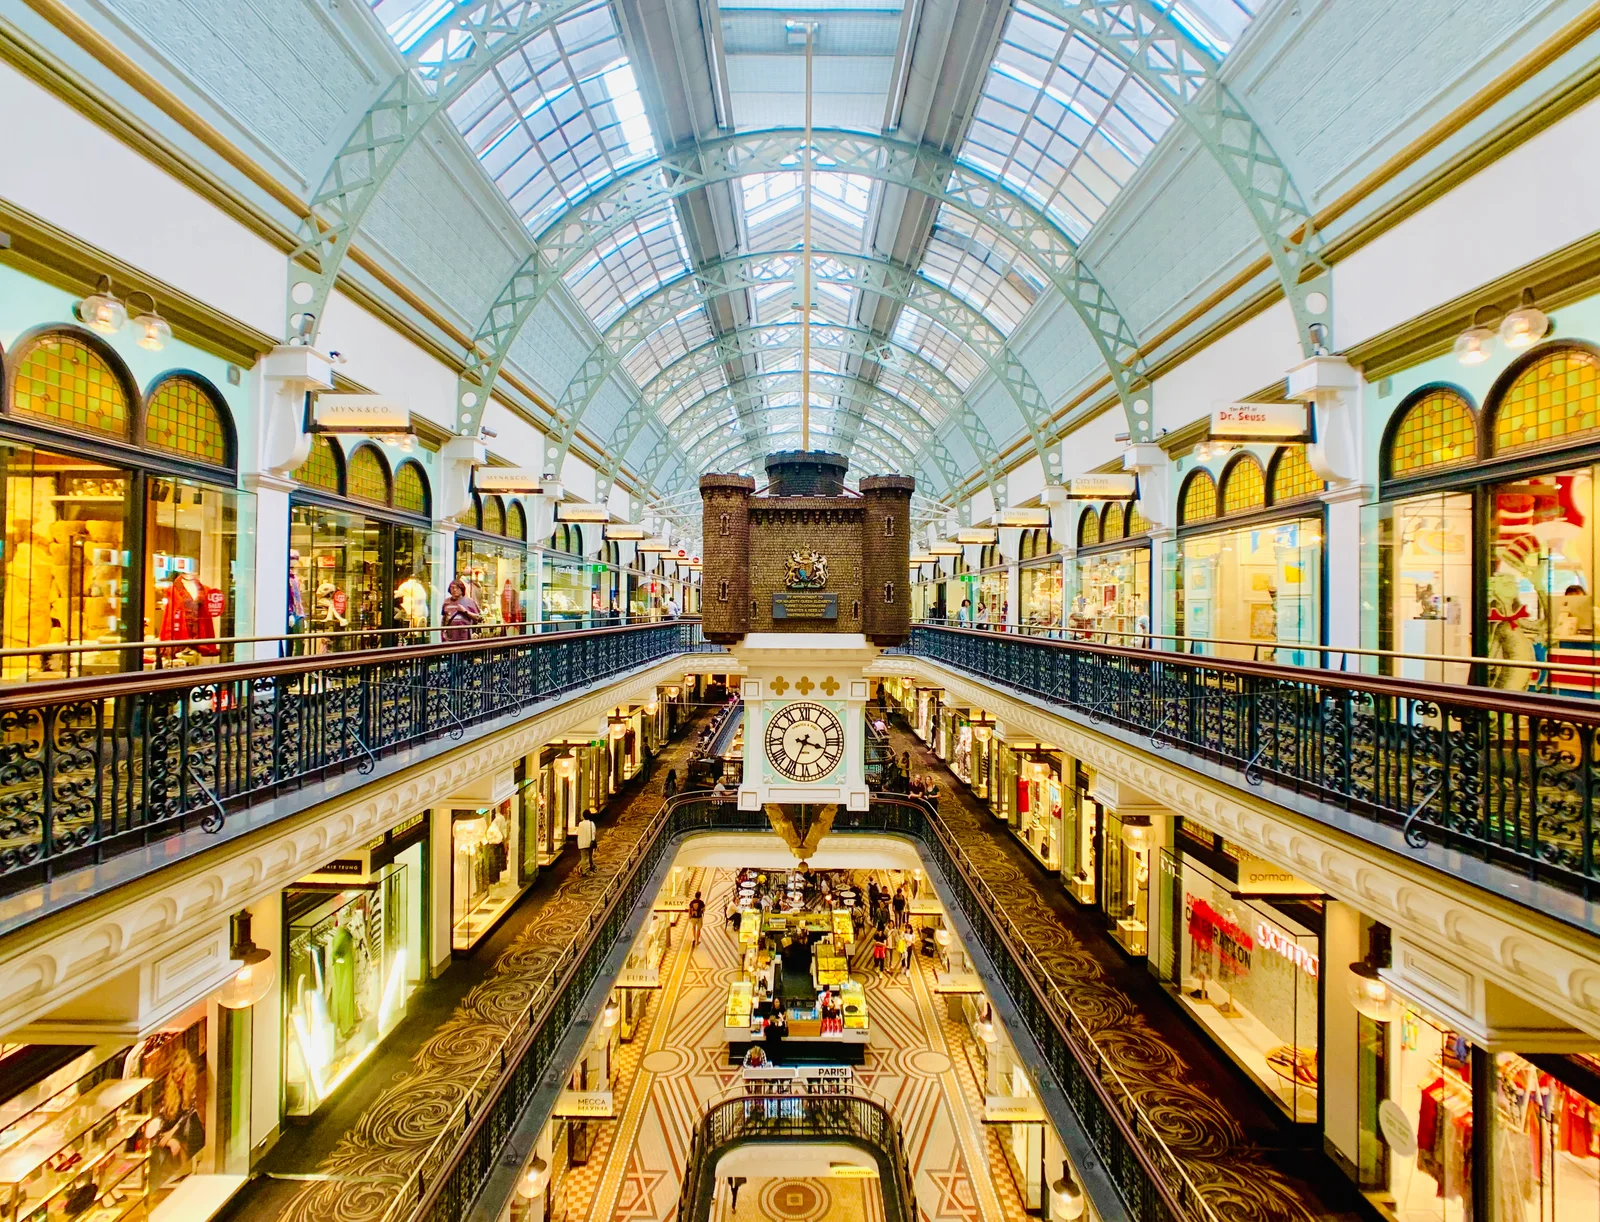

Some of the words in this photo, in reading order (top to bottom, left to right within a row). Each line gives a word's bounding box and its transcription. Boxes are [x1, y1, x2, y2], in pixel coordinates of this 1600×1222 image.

[1219, 411, 1235, 421] Dr.
[1238, 411, 1266, 422] Seuss
[1249, 872, 1294, 884] gorman
[626, 974, 656, 982] FURLA
[818, 1068, 847, 1077] PARISI
